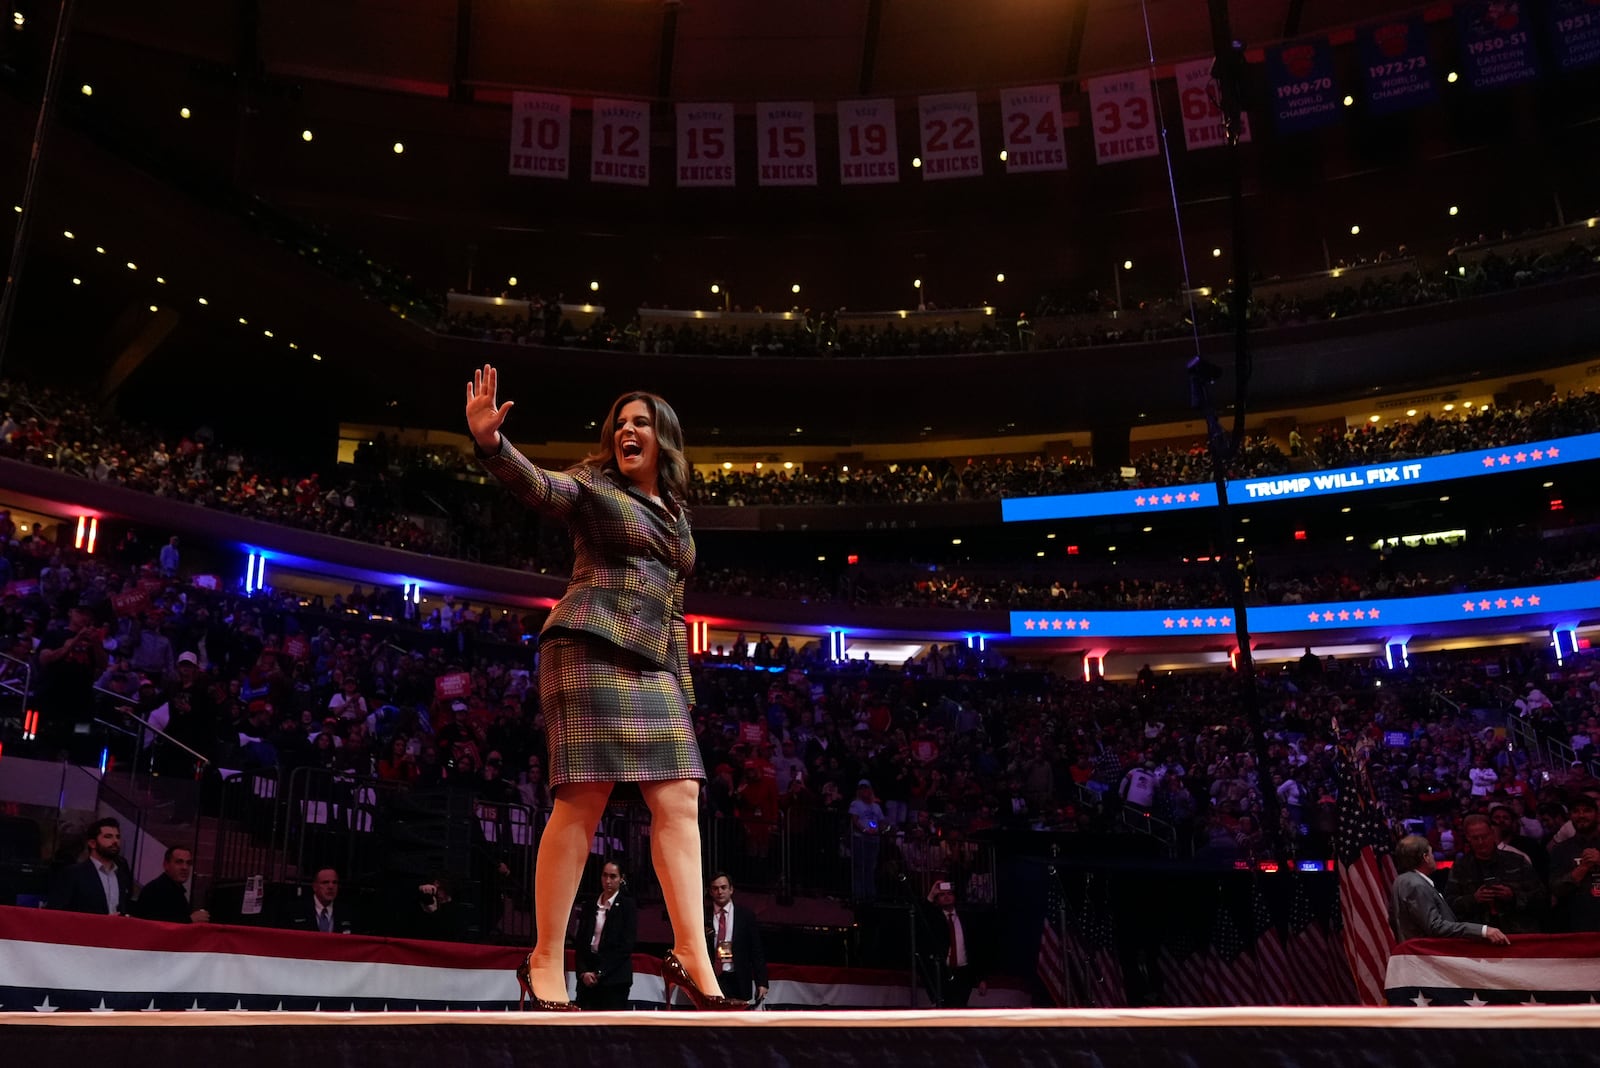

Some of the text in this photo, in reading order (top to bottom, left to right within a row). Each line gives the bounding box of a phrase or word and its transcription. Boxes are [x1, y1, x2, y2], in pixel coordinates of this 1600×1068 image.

[1555, 11, 1600, 33] 1951-
[1467, 31, 1527, 55] 1950-51
[1369, 55, 1428, 79] 1972-73
[1276, 77, 1333, 99] 1969-70
[1371, 80, 1431, 101] CHAMPIONS
[1382, 74, 1418, 89] WORLD
[1279, 102, 1336, 120] CHAMPIONS
[1288, 95, 1323, 108] WORLD
[1096, 97, 1150, 135] 33
[521, 117, 561, 150] 10
[925, 116, 975, 152] 22
[1008, 111, 1058, 145] 24
[601, 124, 640, 157] 12
[687, 127, 725, 159] 15
[767, 125, 806, 158] 15
[848, 123, 888, 156] 19
[1098, 135, 1155, 158] KNICKS
[513, 154, 566, 172] KNICKS
[926, 155, 979, 174] KNICKS
[1009, 149, 1063, 167] KNICKS
[594, 161, 646, 179] KNICKS
[680, 166, 732, 181] KNICKS
[761, 163, 814, 180] KNICKS
[843, 162, 896, 178] KNICKS
[1246, 463, 1422, 498] TRUMP WILL FIX IT
